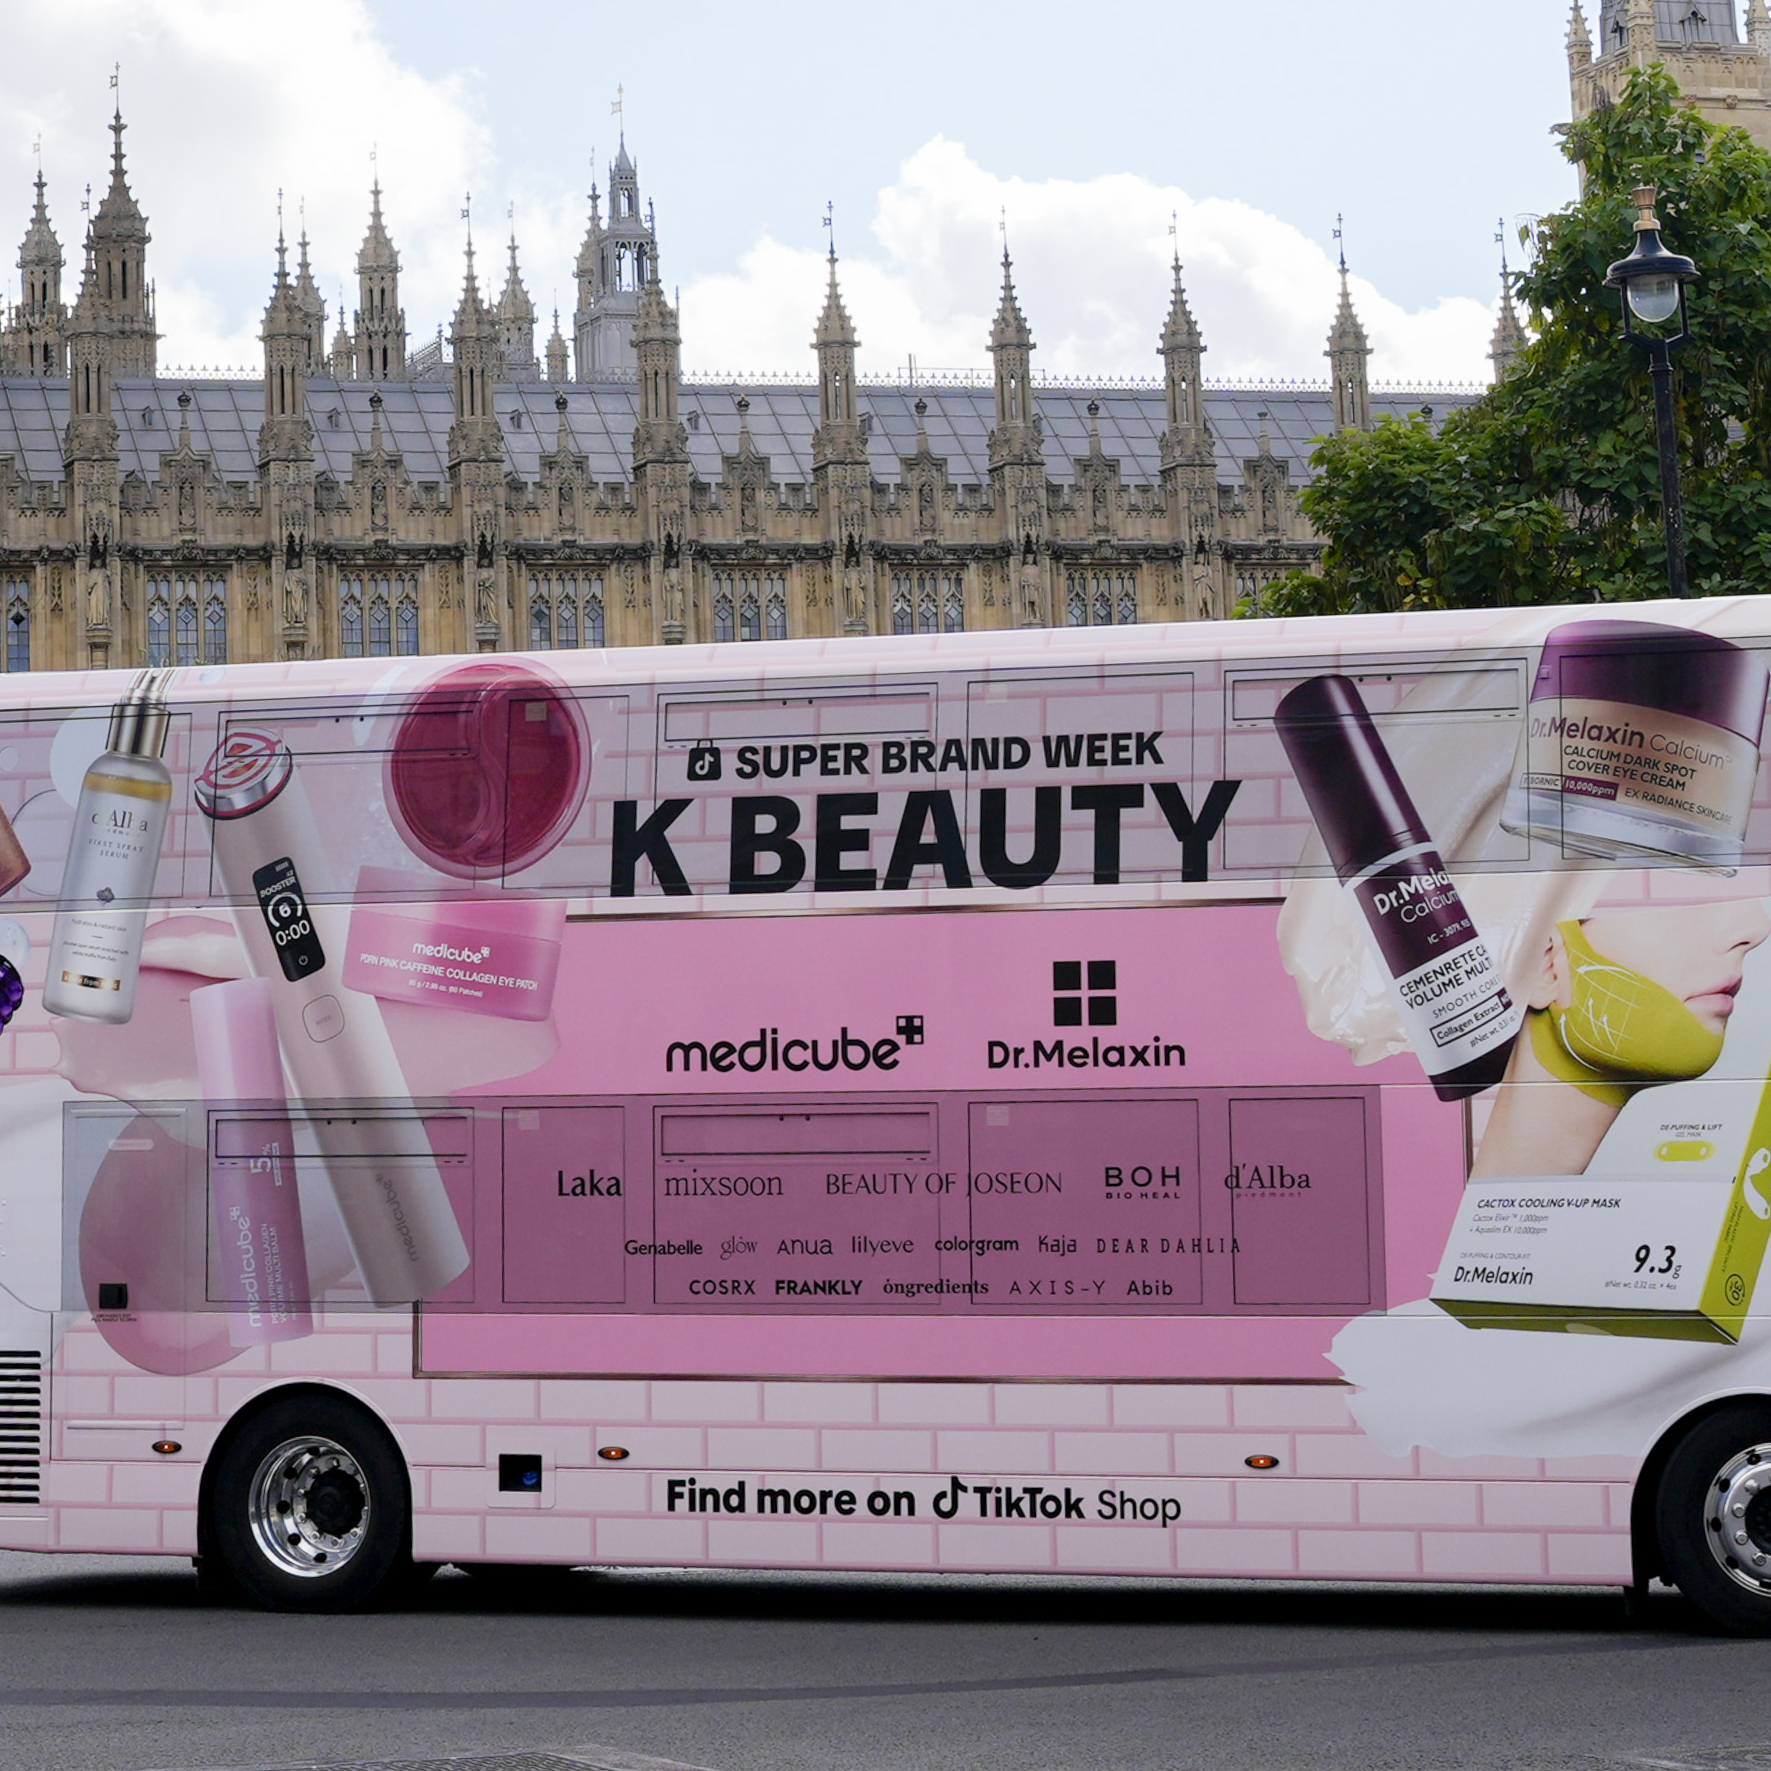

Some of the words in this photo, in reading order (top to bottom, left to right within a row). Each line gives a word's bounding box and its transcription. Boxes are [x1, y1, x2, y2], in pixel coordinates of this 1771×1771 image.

[736, 741, 871, 780] SUPER
[882, 735, 1031, 775] BRAND
[1042, 730, 1165, 768] WEEK
[1530, 716, 1645, 748] Dr.Melaxin
[1649, 733, 1725, 769] Calcium
[1564, 744, 1621, 764] CALCIUM
[1623, 753, 1661, 772] DARK
[1663, 761, 1698, 780] SPOT
[1567, 759, 1610, 776] COVER
[1613, 767, 1637, 779] EYE
[1639, 771, 1687, 792] CREAM
[1625, 787, 1640, 798] EX
[1642, 790, 1695, 814] RADIANCE
[116, 841, 145, 853] SPRAY
[609, 797, 695, 898] K
[728, 778, 1243, 895] BEAUTY
[99, 848, 130, 860] SERUM
[260, 876, 297, 899] BOOSTER
[279, 902, 291, 917] 6
[275, 919, 311, 947] 0:00
[412, 942, 483, 965] medicube
[379, 956, 399, 969] PINK
[399, 960, 445, 977] CAFFEINE
[446, 967, 497, 985] COLLAGEN
[498, 976, 515, 988] EYE
[1399, 949, 1476, 998] CEMENRETE
[1405, 972, 1466, 1010] VOLUME
[1431, 989, 1478, 1020] SMOOTH
[1436, 1014, 1474, 1041] Collagen
[1474, 1000, 1502, 1022] Extract
[665, 1027, 902, 1073] medicube
[987, 1035, 1186, 1070] Dr.Melaxin
[557, 1169, 623, 1198] Laka
[663, 1168, 784, 1197] mixsoon
[825, 1172, 919, 1196] BEAUTY
[925, 1171, 958, 1194] OF
[966, 1171, 1063, 1197] JOSEON
[1104, 1165, 1182, 1188] BOH
[1223, 1163, 1312, 1191] d'Alba
[1105, 1191, 1132, 1200] BIO
[1139, 1190, 1181, 1200] HEAL
[1477, 1198, 1517, 1209] CACTOX
[1518, 1198, 1568, 1209] COOLING
[1567, 1198, 1590, 1209] V-UP
[1590, 1198, 1622, 1209] MASK
[382, 1179, 420, 1263] medicube
[260, 1223, 274, 1274] COLLAGEN
[624, 1238, 704, 1256] Genabelle
[776, 1238, 834, 1256] Anua
[850, 1235, 915, 1258] lilyeve
[934, 1235, 1019, 1257] colorgram
[1038, 1234, 1078, 1257] Kaja
[1096, 1238, 1151, 1254] DEAR
[1160, 1238, 1242, 1255] DAHLIA
[236, 1215, 263, 1328] medicube
[1453, 1265, 1535, 1286] Dr.Melaxin
[688, 1279, 756, 1296] COSRX
[775, 1279, 864, 1296] FRANKLY
[1126, 1279, 1174, 1296] Abib
[1730, 1280, 1742, 1302] 30
[666, 1478, 746, 1514] Find
[756, 1488, 858, 1517] more
[866, 1489, 917, 1517] on
[972, 1485, 1087, 1520] TikTok
[1096, 1489, 1182, 1528] Shop
